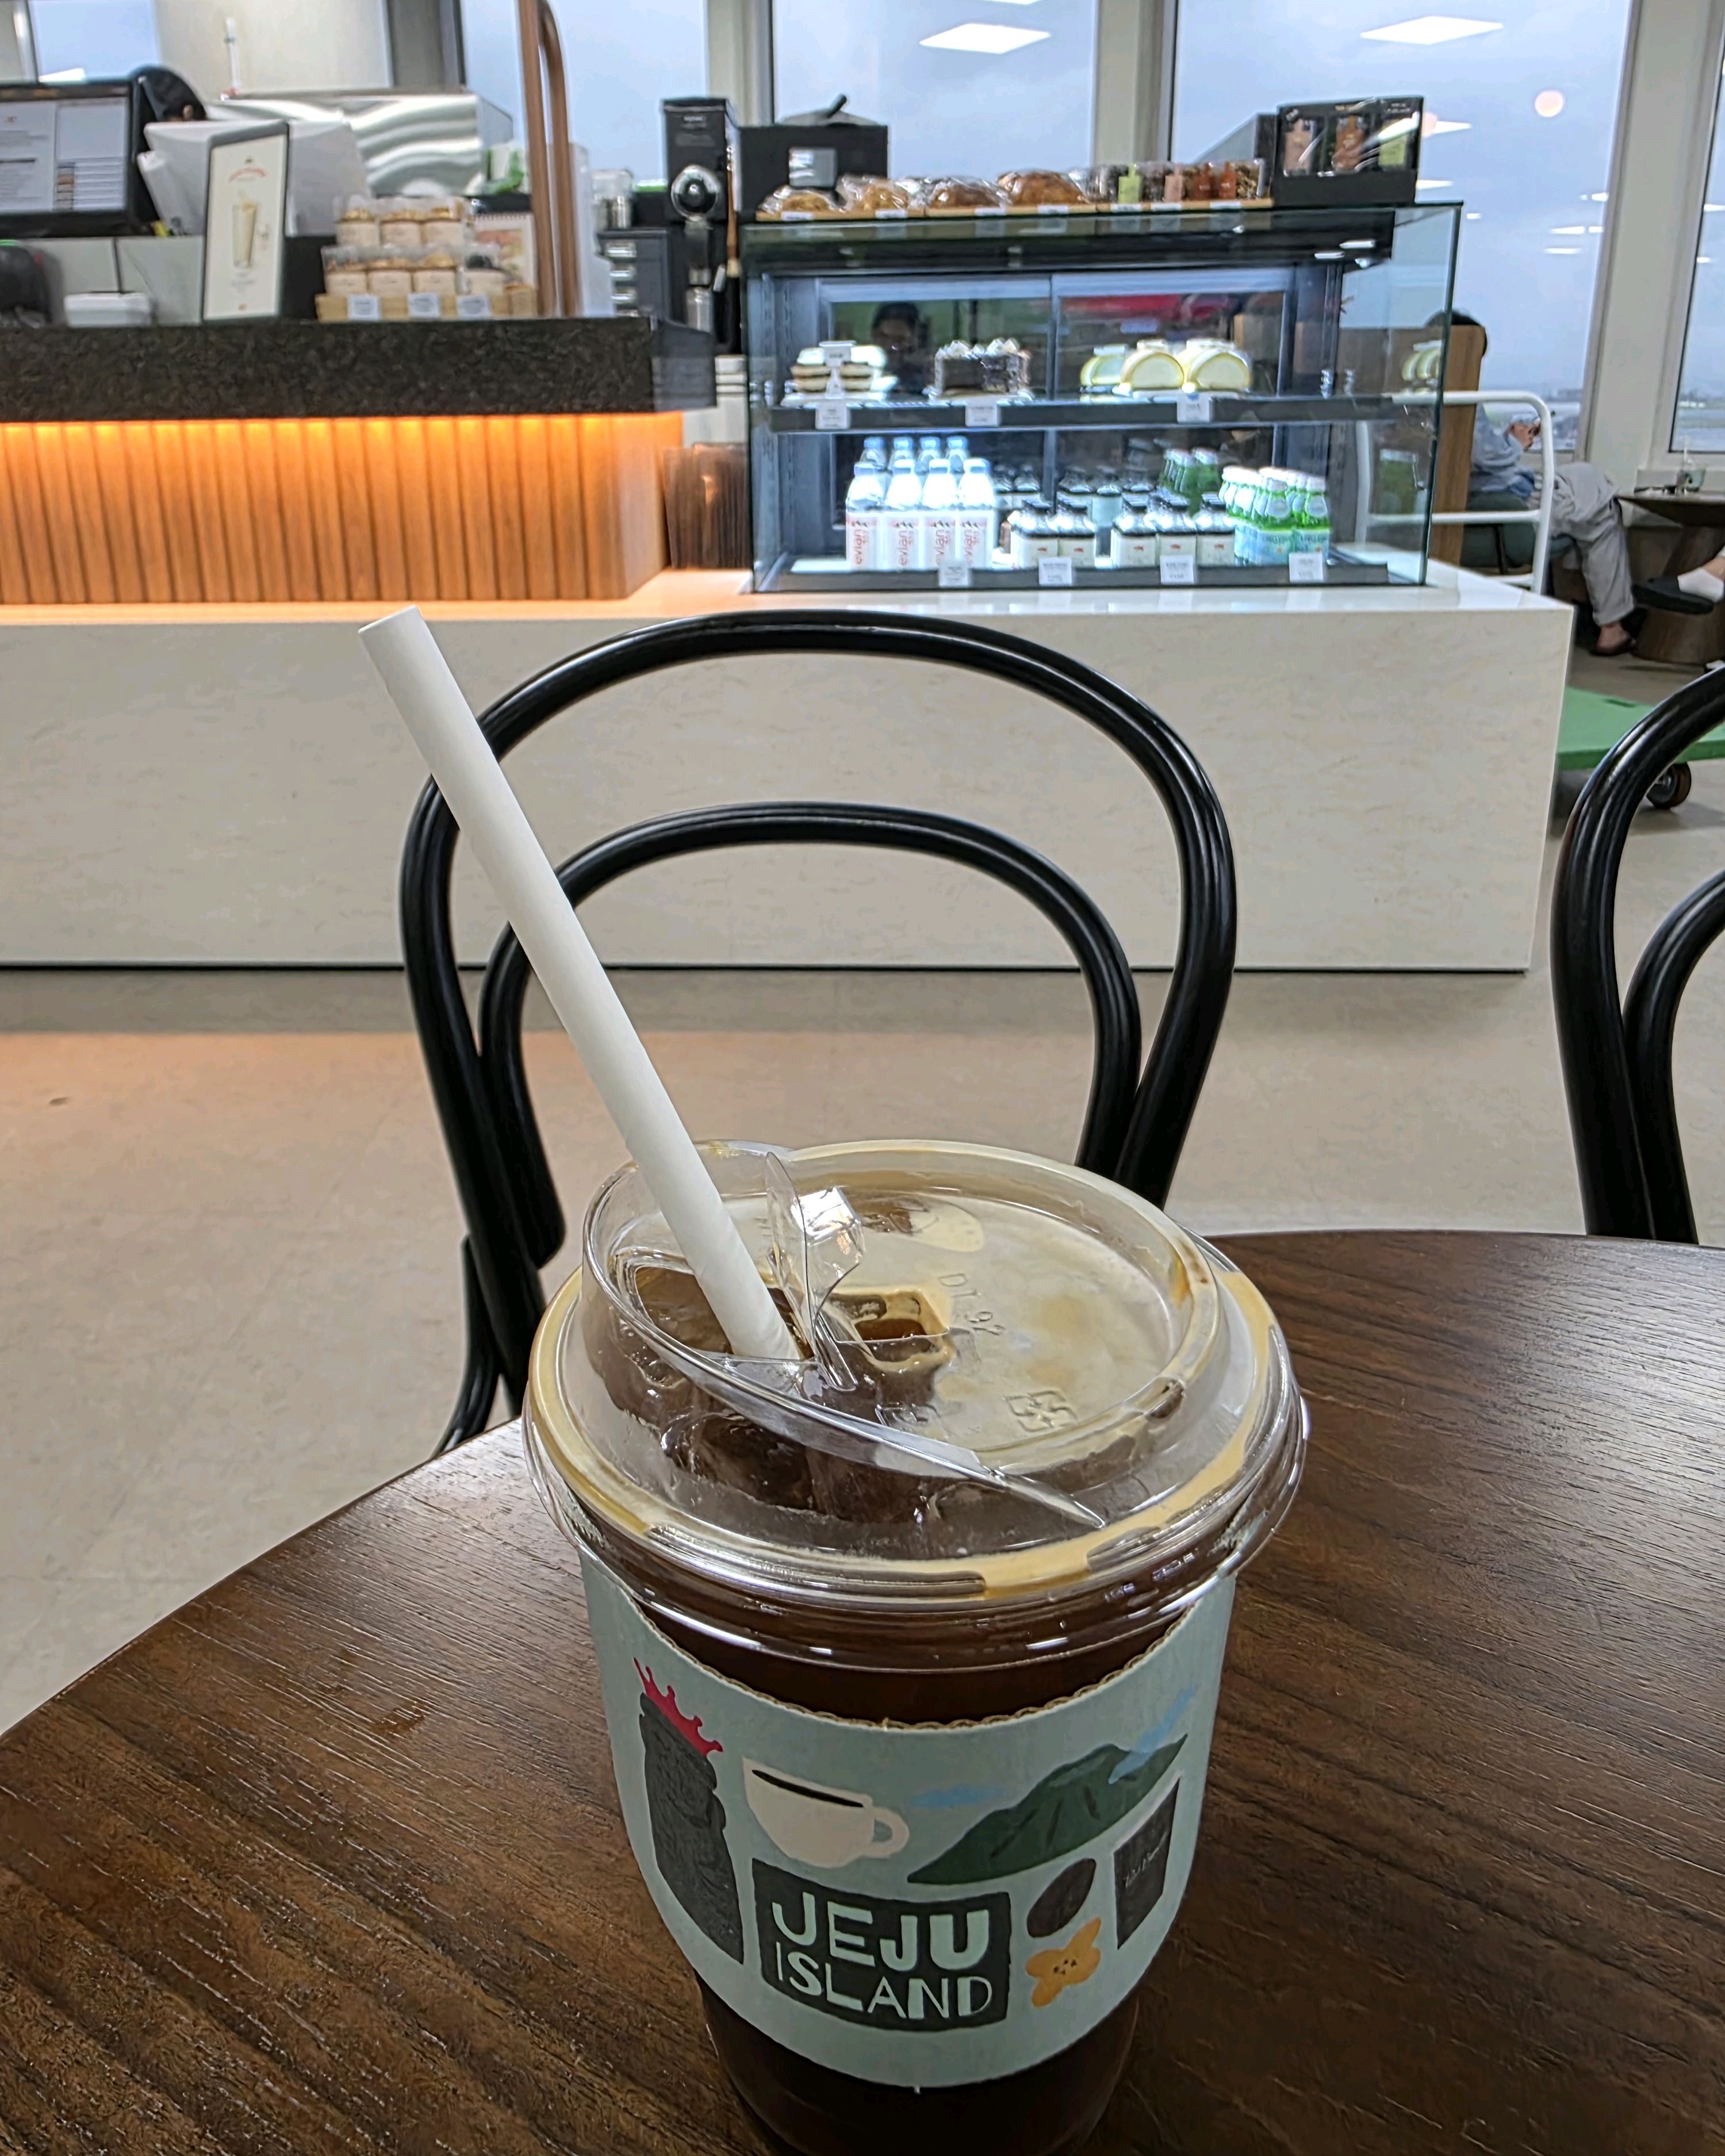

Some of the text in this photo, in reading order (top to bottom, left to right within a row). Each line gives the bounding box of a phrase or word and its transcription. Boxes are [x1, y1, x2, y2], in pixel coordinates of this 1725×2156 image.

[854, 529, 862, 565] evian
[898, 530, 908, 566] evian
[772, 1892, 990, 1971] JEJU
[776, 1941, 992, 2019] ISLAND
